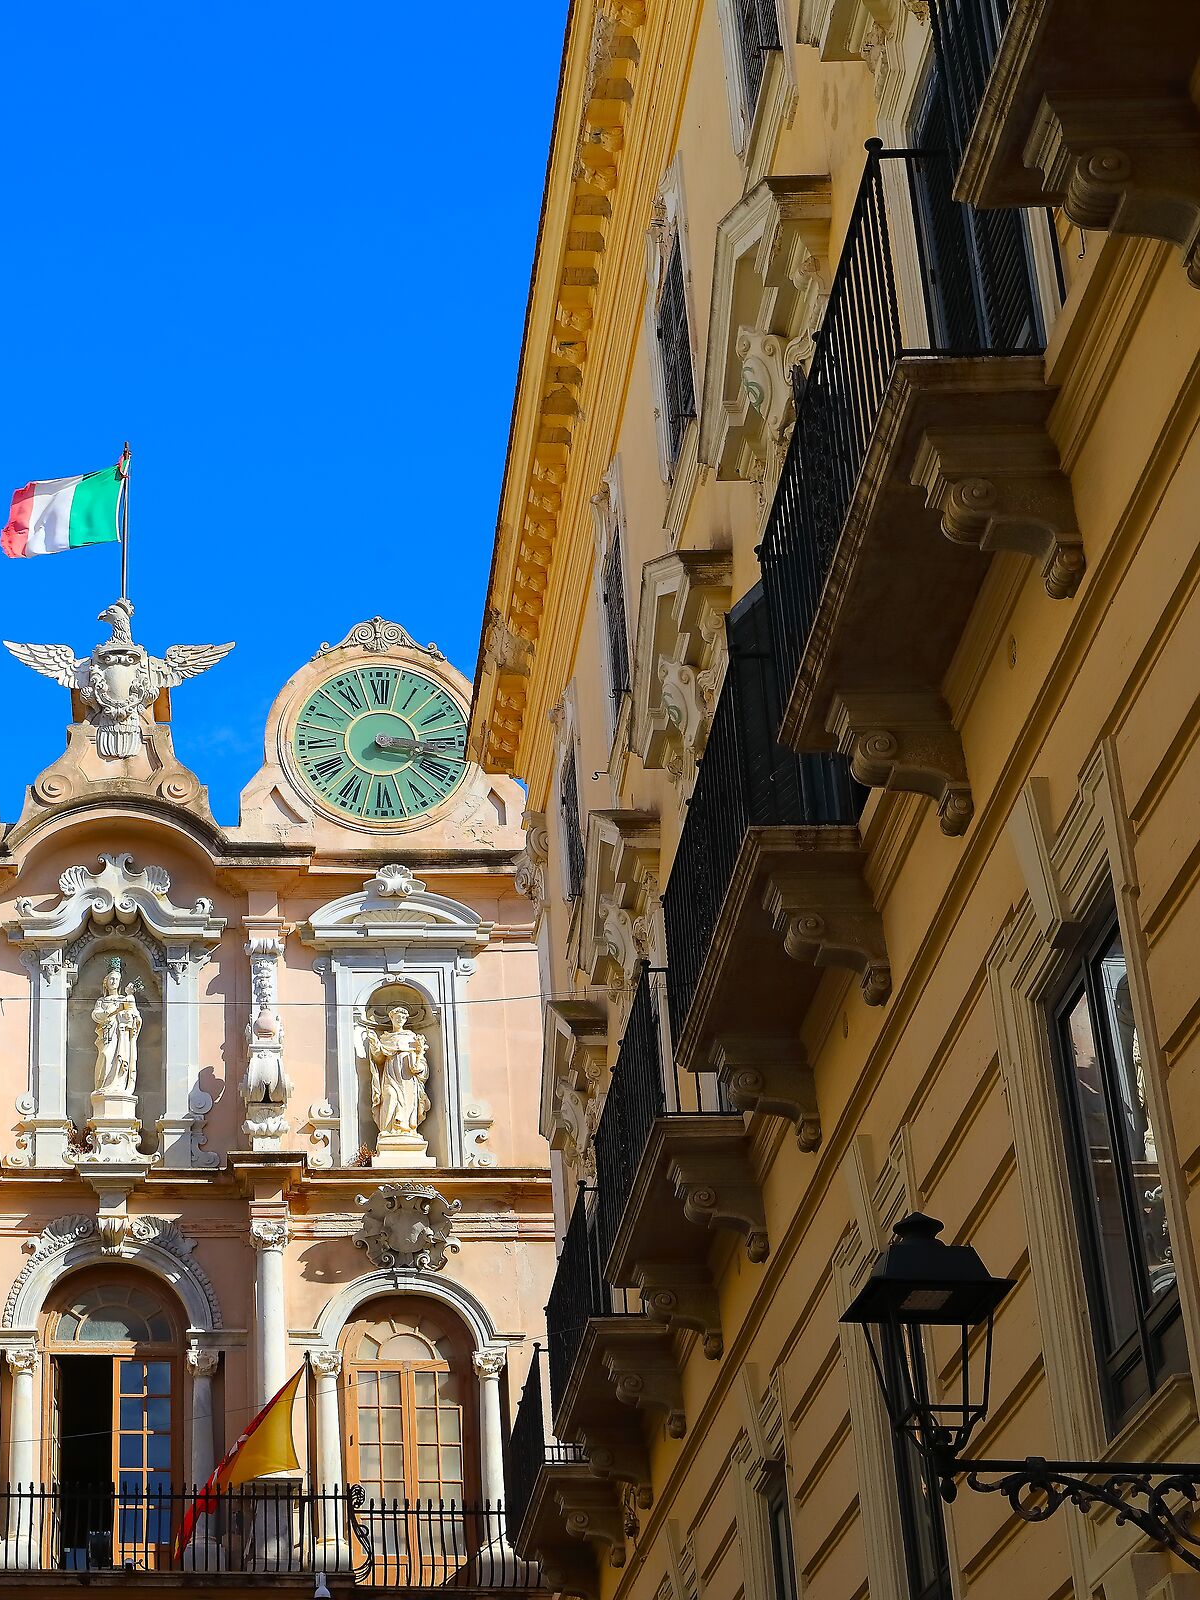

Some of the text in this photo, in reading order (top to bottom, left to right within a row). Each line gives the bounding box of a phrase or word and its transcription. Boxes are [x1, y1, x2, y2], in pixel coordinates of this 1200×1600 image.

[337, 685, 363, 712] XI
[369, 679, 390, 705] XII
[401, 687, 419, 711] I
[420, 707, 447, 727] II
[307, 735, 337, 749] IX
[313, 755, 346, 784] VIII
[338, 773, 363, 804] VII
[376, 781, 393, 809] VI
[405, 777, 426, 802] V
